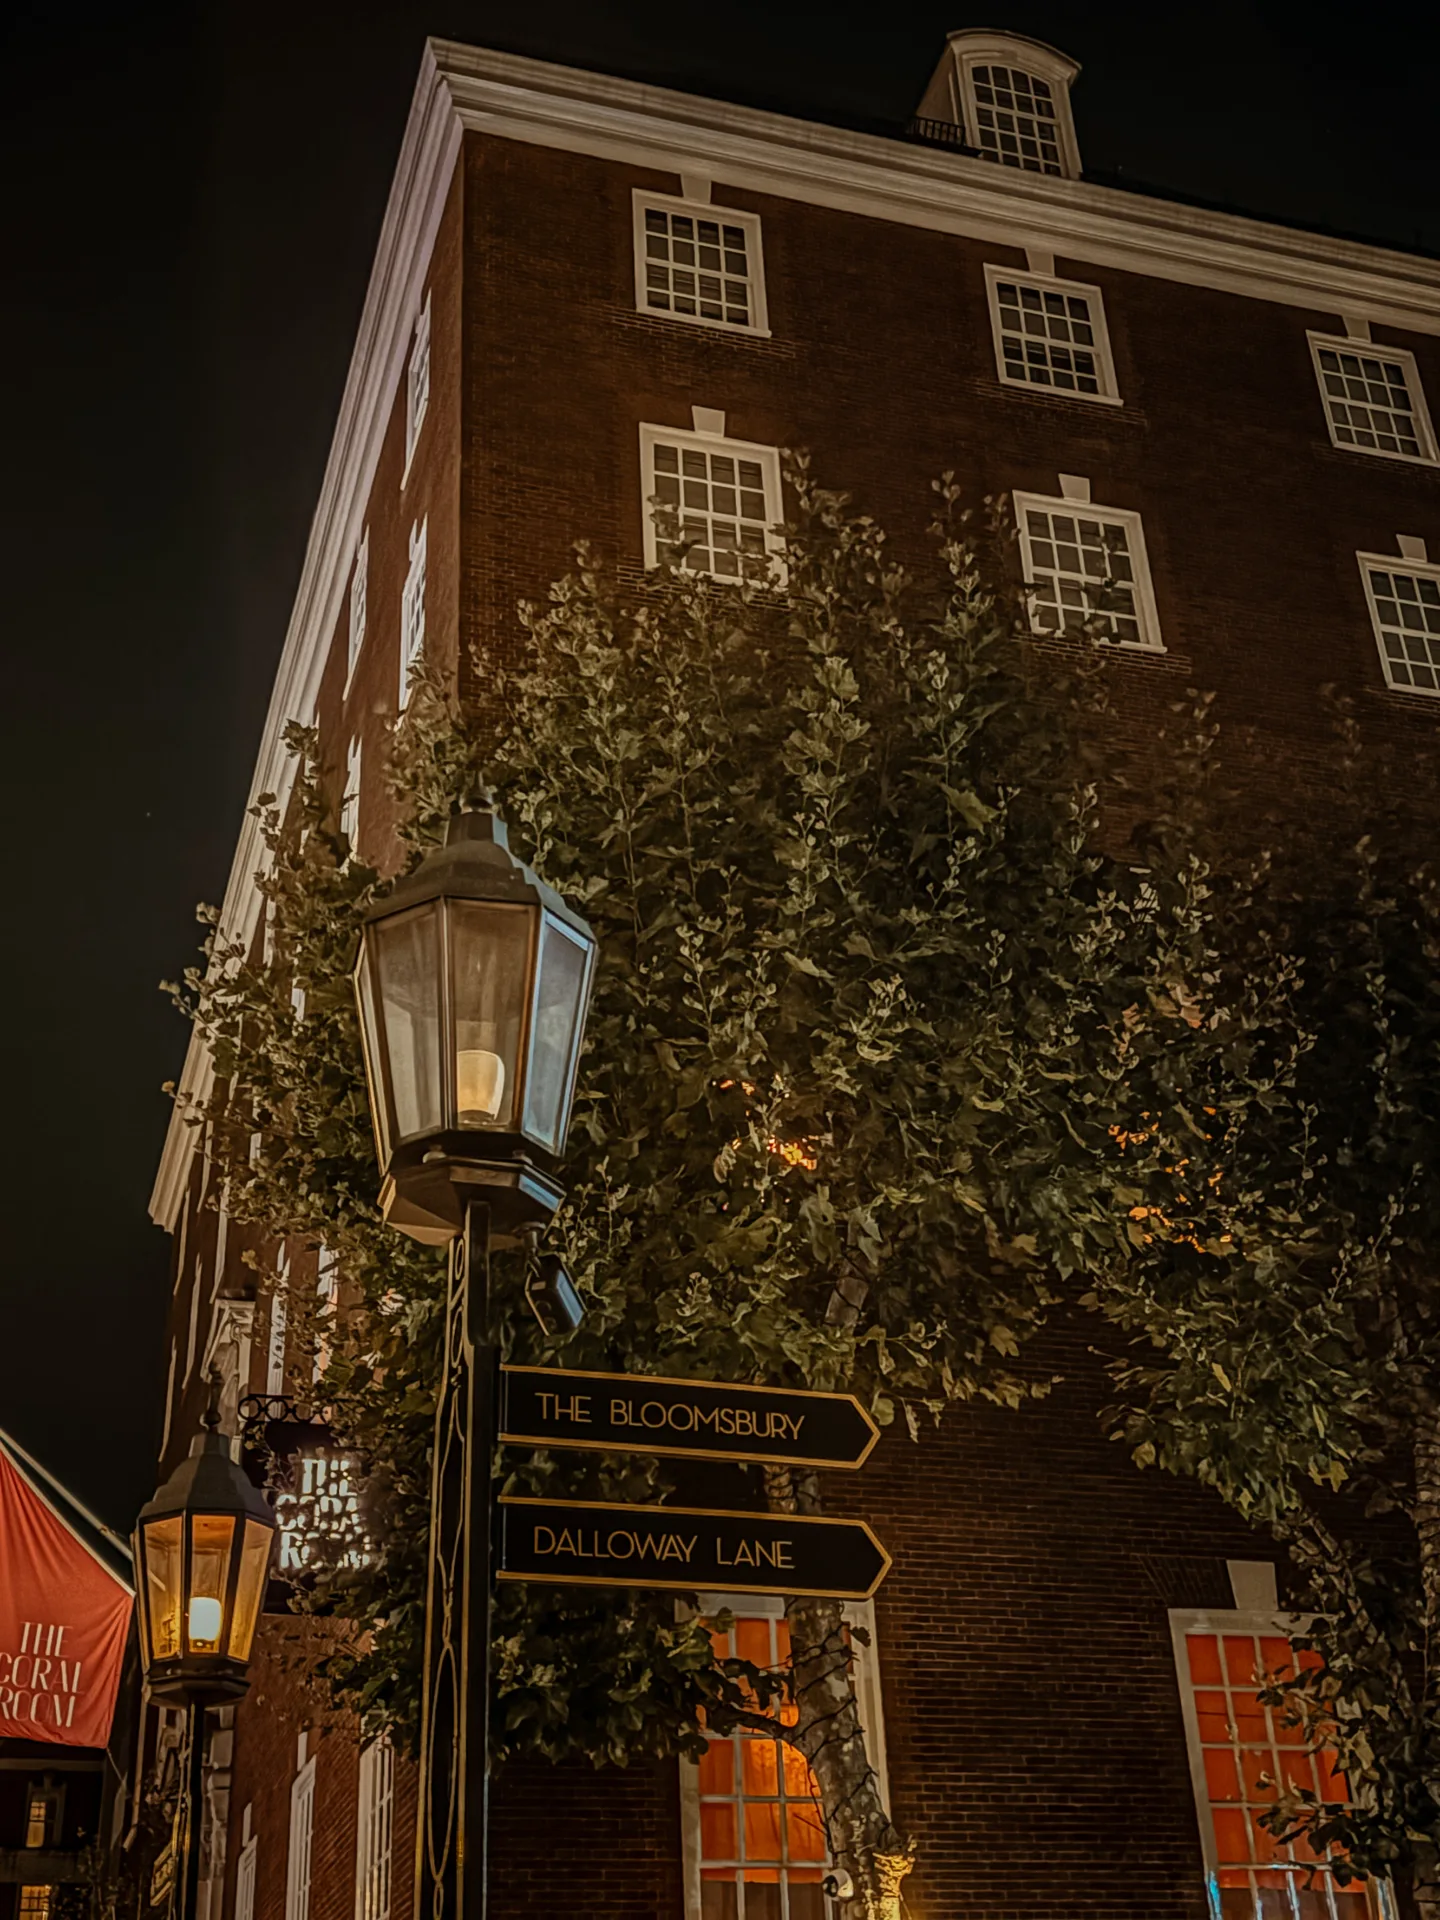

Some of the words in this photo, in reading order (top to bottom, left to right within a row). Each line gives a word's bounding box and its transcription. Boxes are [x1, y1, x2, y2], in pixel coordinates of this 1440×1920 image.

[534, 1392, 592, 1423] THE
[610, 1399, 805, 1440] BLOOMSBURY
[533, 1525, 698, 1563] DALLOWAY
[716, 1536, 796, 1569] LANE
[20, 1621, 74, 1658] THE
[0, 1652, 85, 1694] CORAL
[0, 1686, 76, 1728] ROOM
